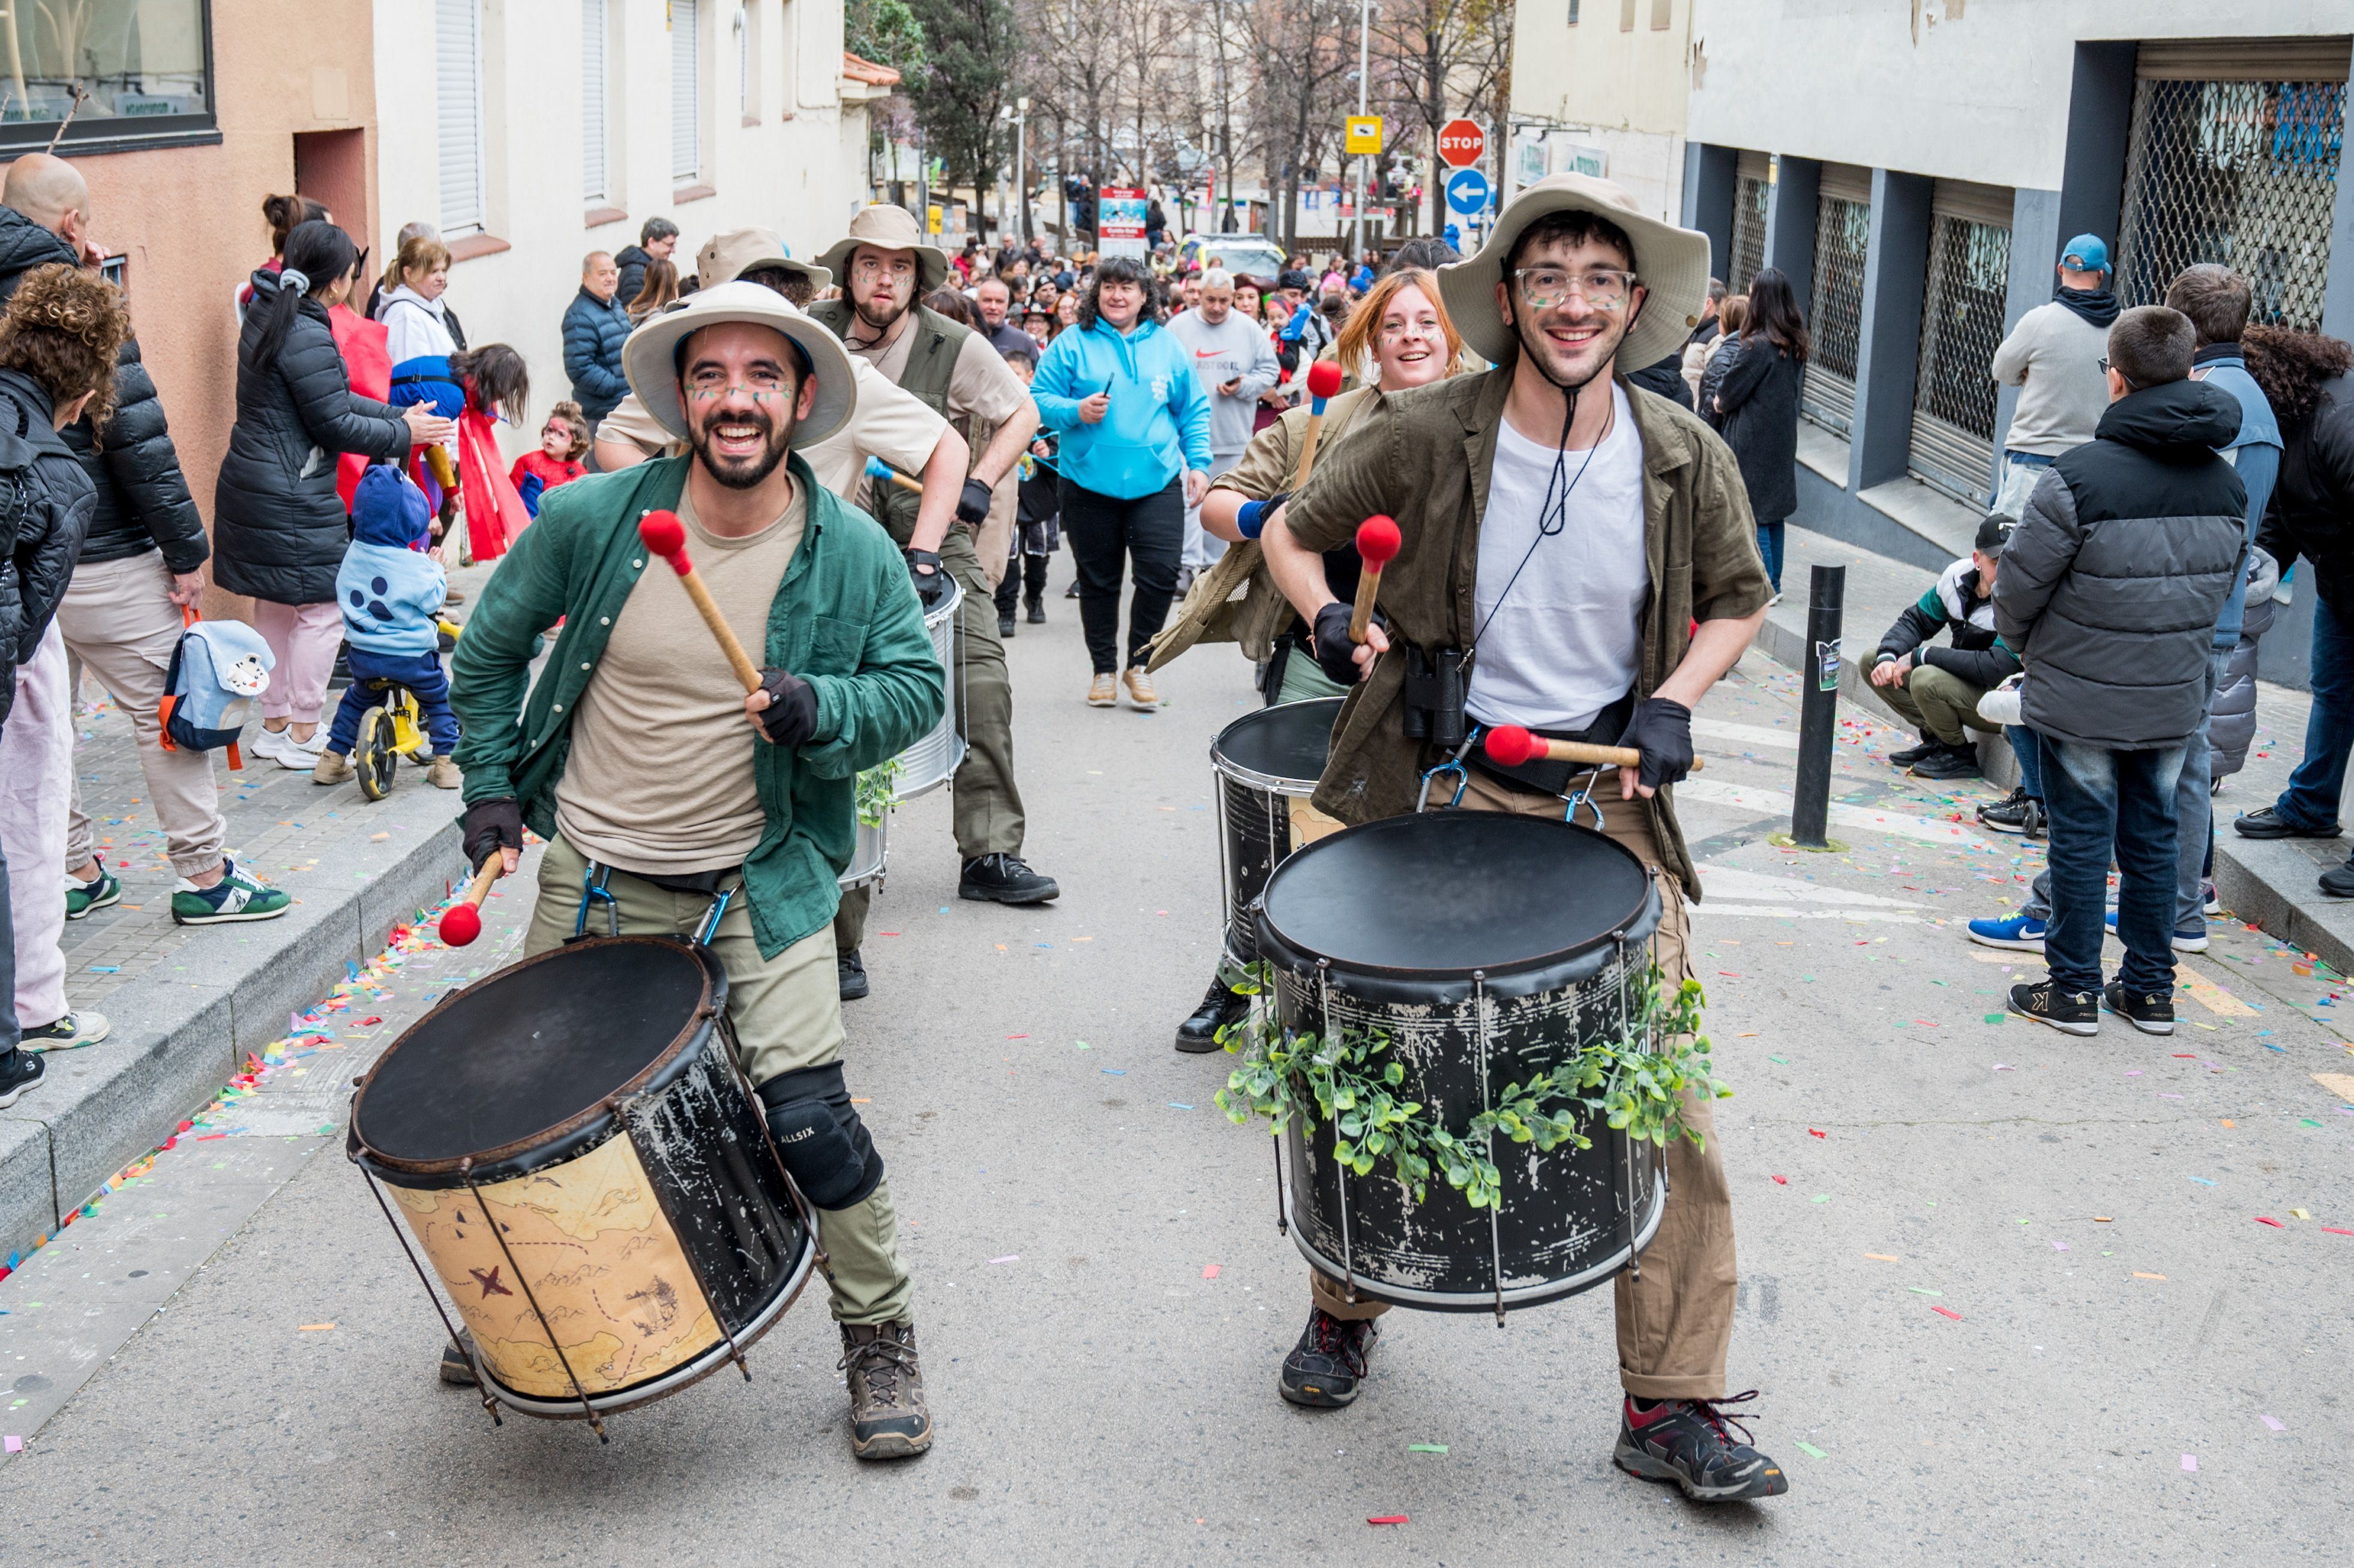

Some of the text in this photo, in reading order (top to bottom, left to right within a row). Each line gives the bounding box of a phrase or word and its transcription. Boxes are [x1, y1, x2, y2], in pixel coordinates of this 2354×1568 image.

[1441, 137, 1482, 149] STOP
[1197, 361, 1215, 369] JUST
[25, 1060, 35, 1072] S
[781, 1126, 815, 1144] ALLSIX
